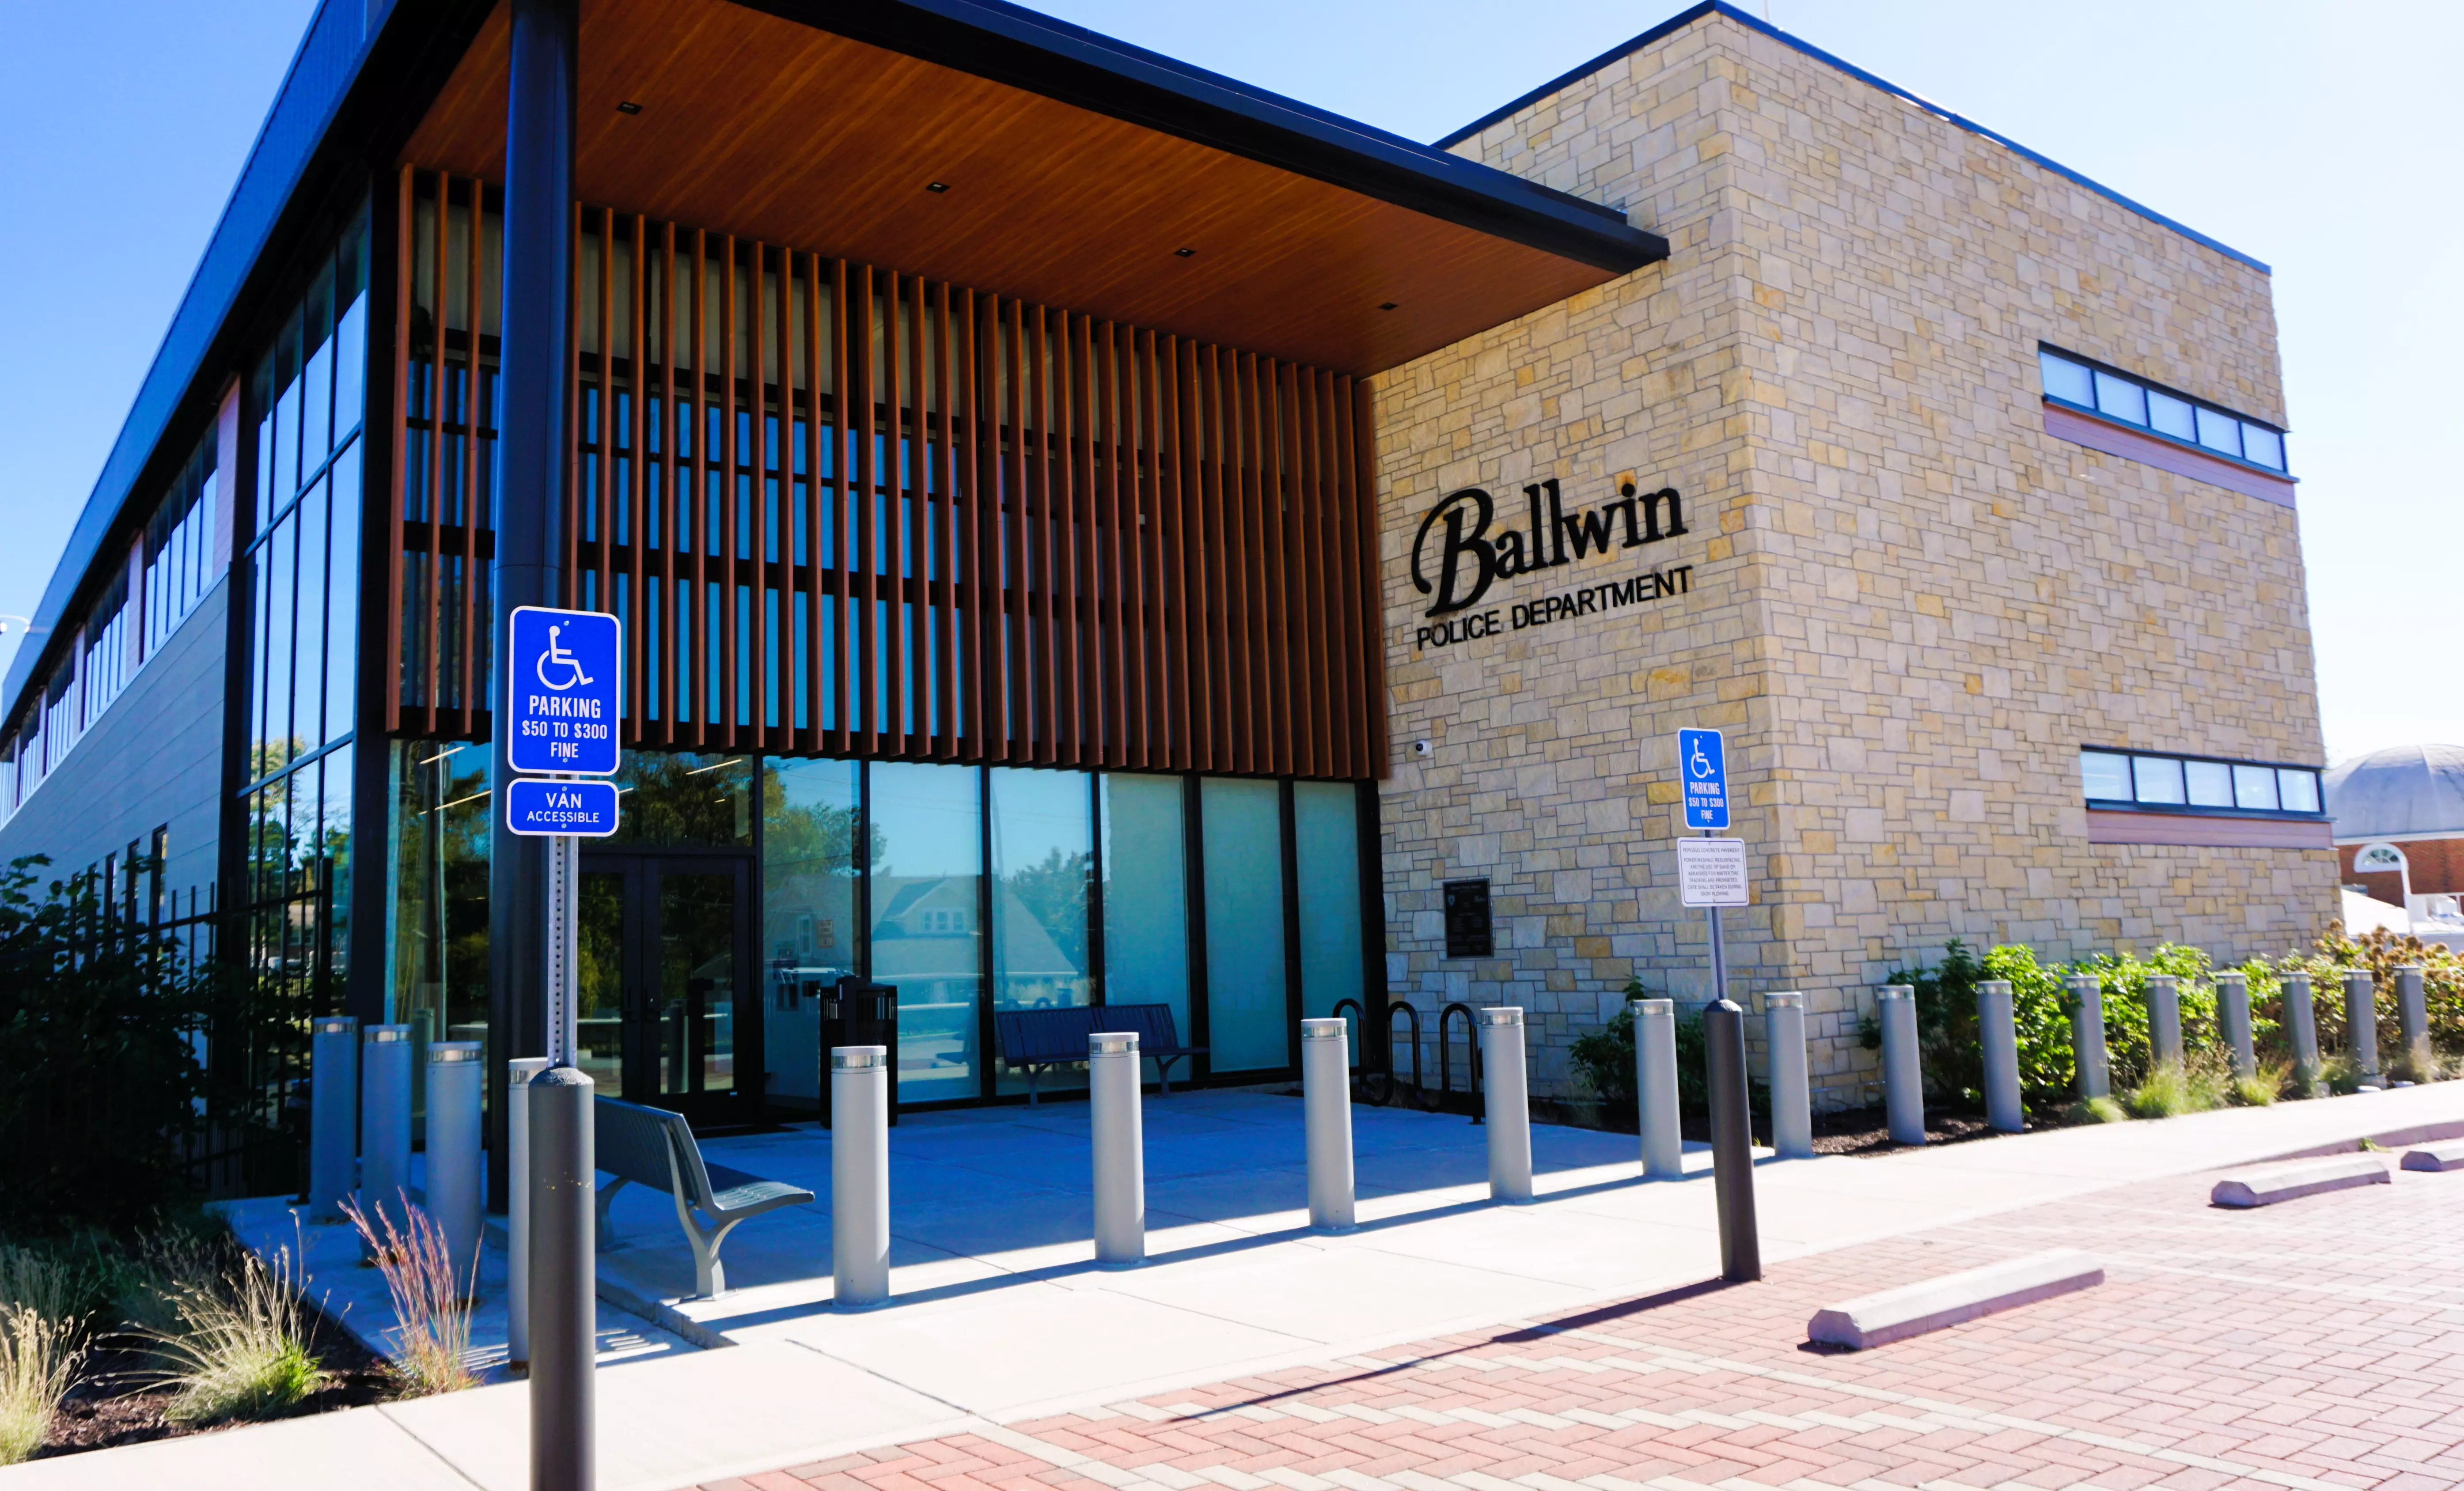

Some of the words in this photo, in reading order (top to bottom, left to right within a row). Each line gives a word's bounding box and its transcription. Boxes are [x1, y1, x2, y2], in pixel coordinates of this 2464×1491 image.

[1411, 478, 1688, 618] Ballwin
[1417, 610, 1500, 651] POLICE
[1512, 565, 1693, 630] DEPARTMENT
[529, 695, 601, 719] PARKING
[522, 720, 547, 737] $50
[553, 722, 568, 738] TO
[574, 723, 607, 739] $300
[551, 742, 579, 758] FINE
[1690, 782, 1720, 795] PARKING
[546, 793, 581, 809] VAN
[1700, 798, 1708, 807] TO
[527, 811, 599, 823] ACCESSIBLE
[1701, 810, 1713, 820] FINE
